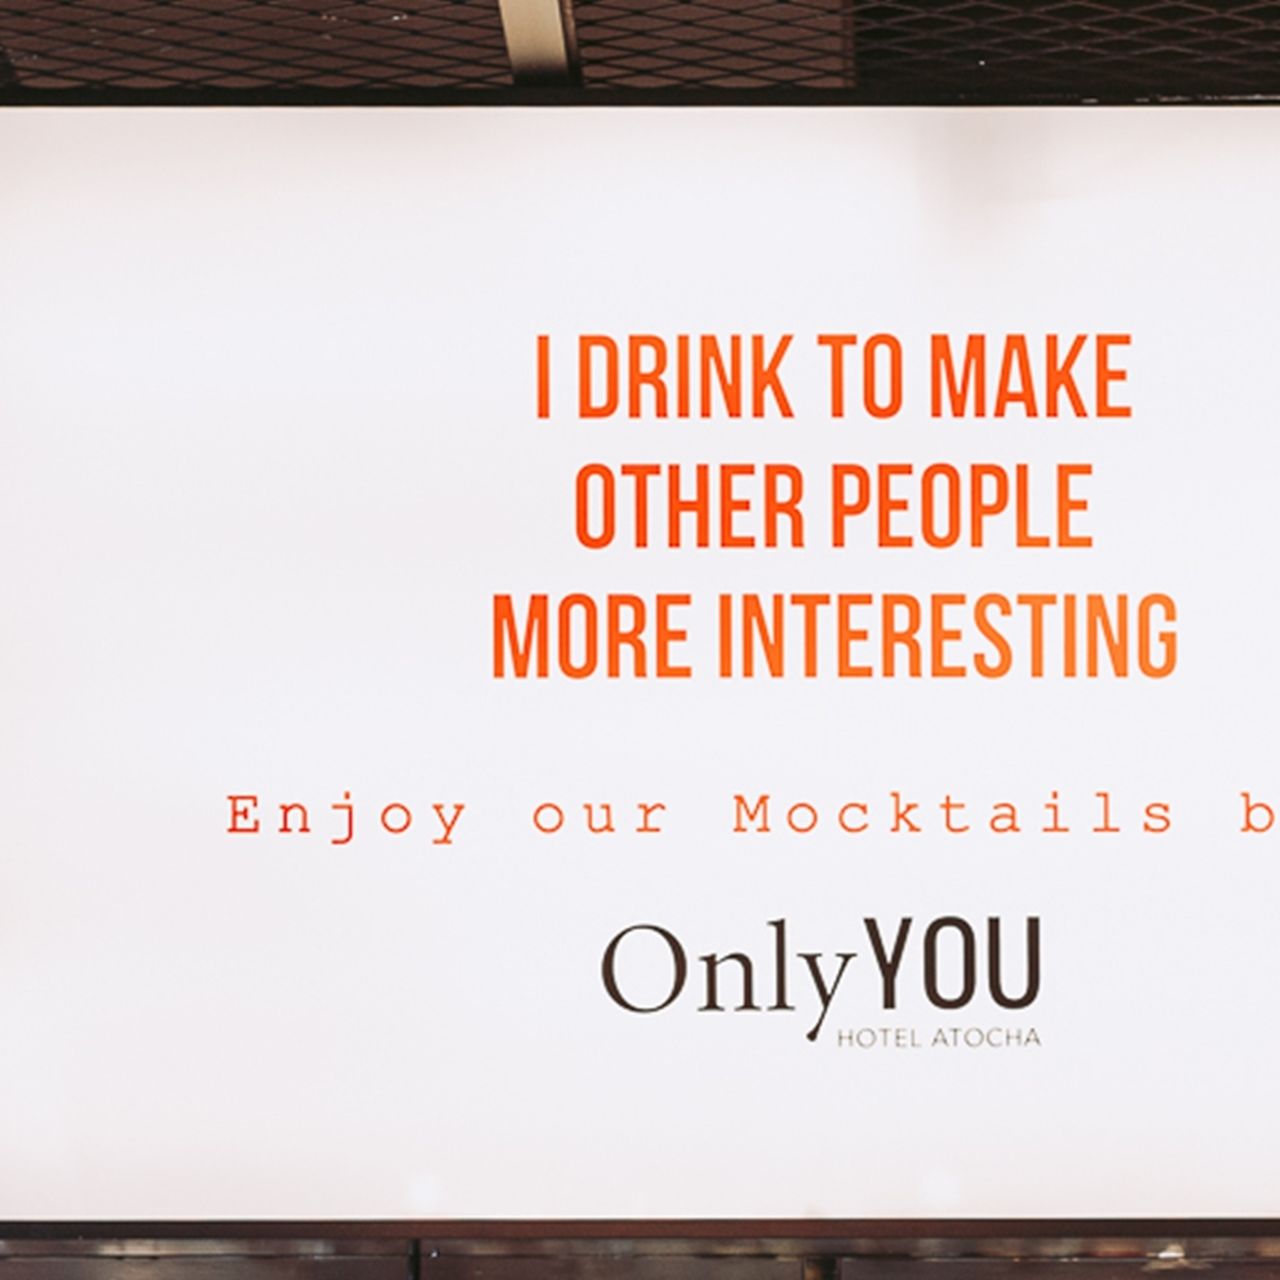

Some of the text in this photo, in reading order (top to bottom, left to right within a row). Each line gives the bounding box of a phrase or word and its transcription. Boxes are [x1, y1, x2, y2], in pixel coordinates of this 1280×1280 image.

[537, 333, 1131, 419] I DRINK TO MAKE
[576, 463, 1092, 549] OTHER PEOPLE
[493, 593, 1176, 679] MORE INTERESTING
[228, 792, 466, 845] Enjoy
[533, 802, 667, 834] our
[733, 792, 1172, 834] Mocktails
[838, 1027, 1042, 1048] HOTEL ATOCHA
